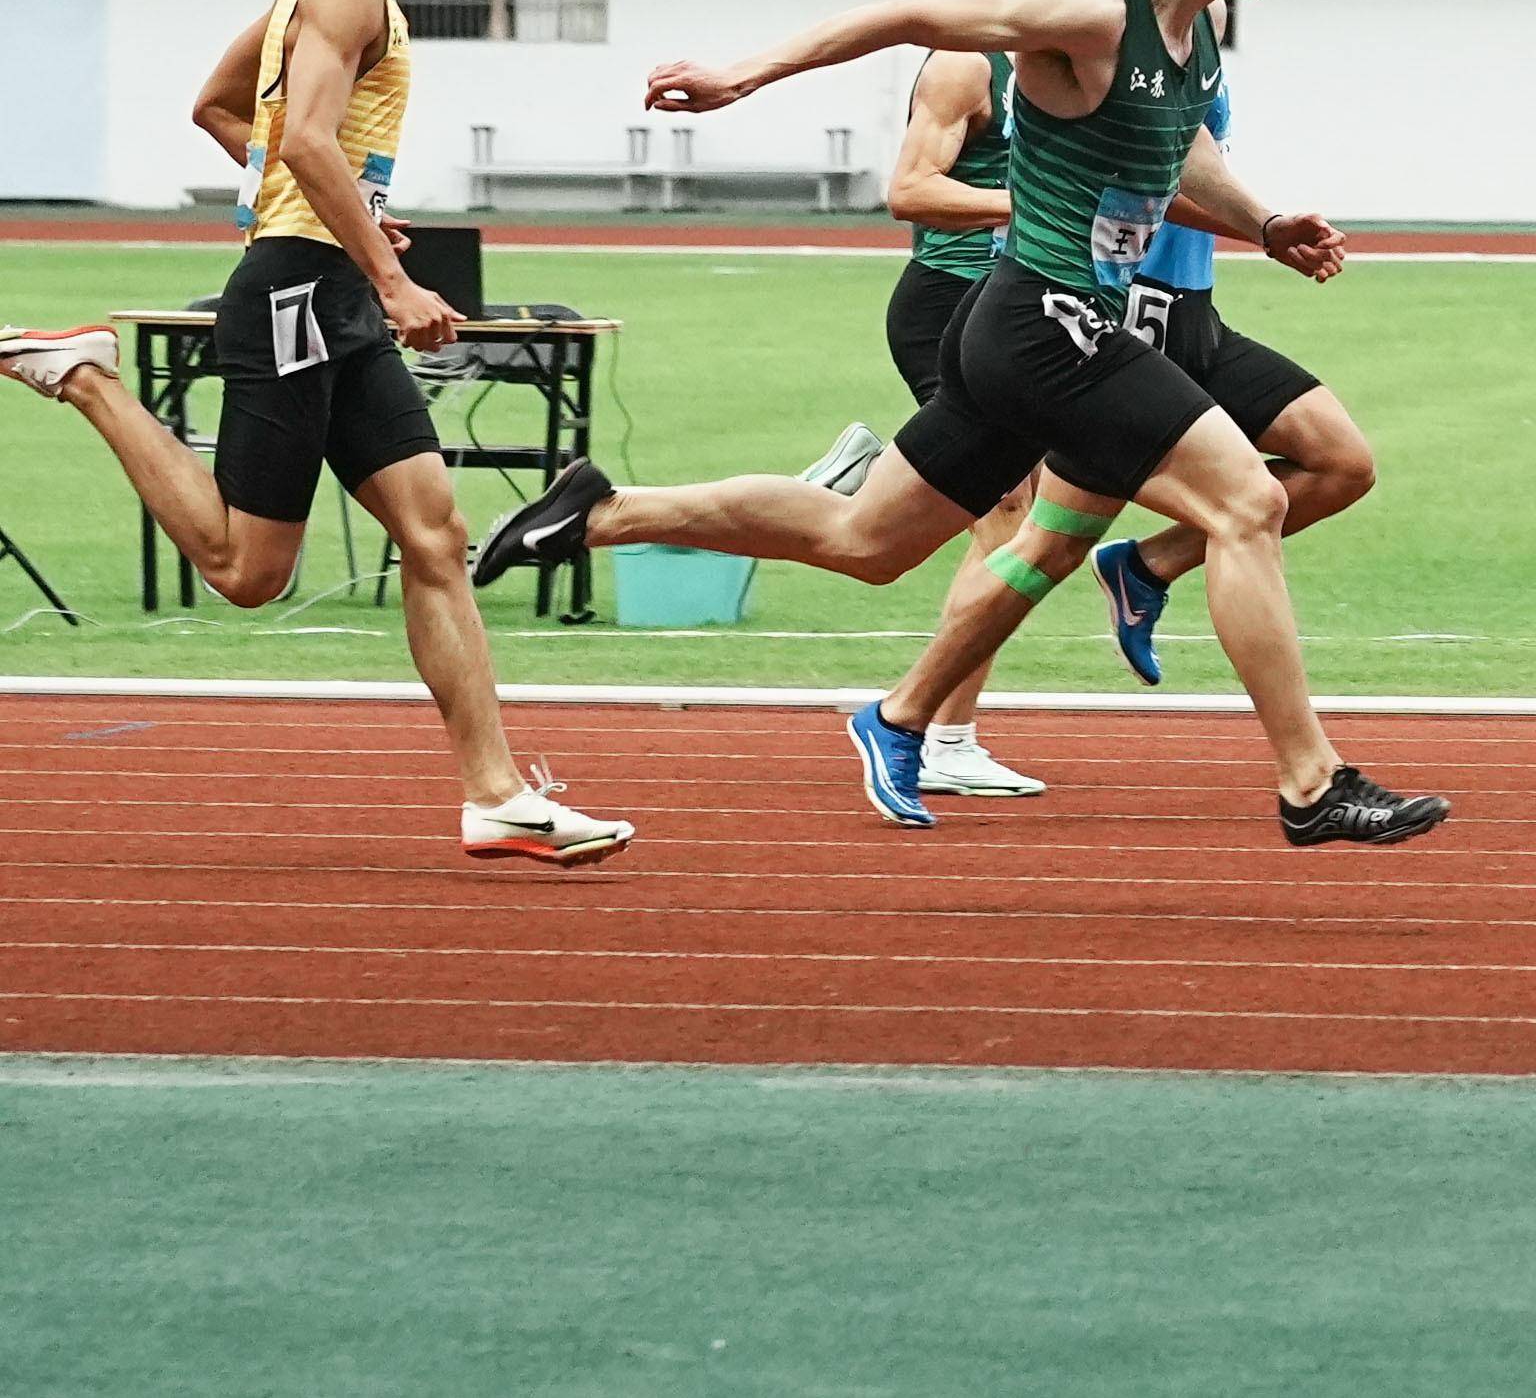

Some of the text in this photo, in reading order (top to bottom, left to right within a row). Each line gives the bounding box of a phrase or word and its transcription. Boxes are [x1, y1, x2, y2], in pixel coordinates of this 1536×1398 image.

[1129, 66, 1167, 100] 江苏
[275, 288, 312, 365] 7
[1137, 294, 1169, 354] 5
